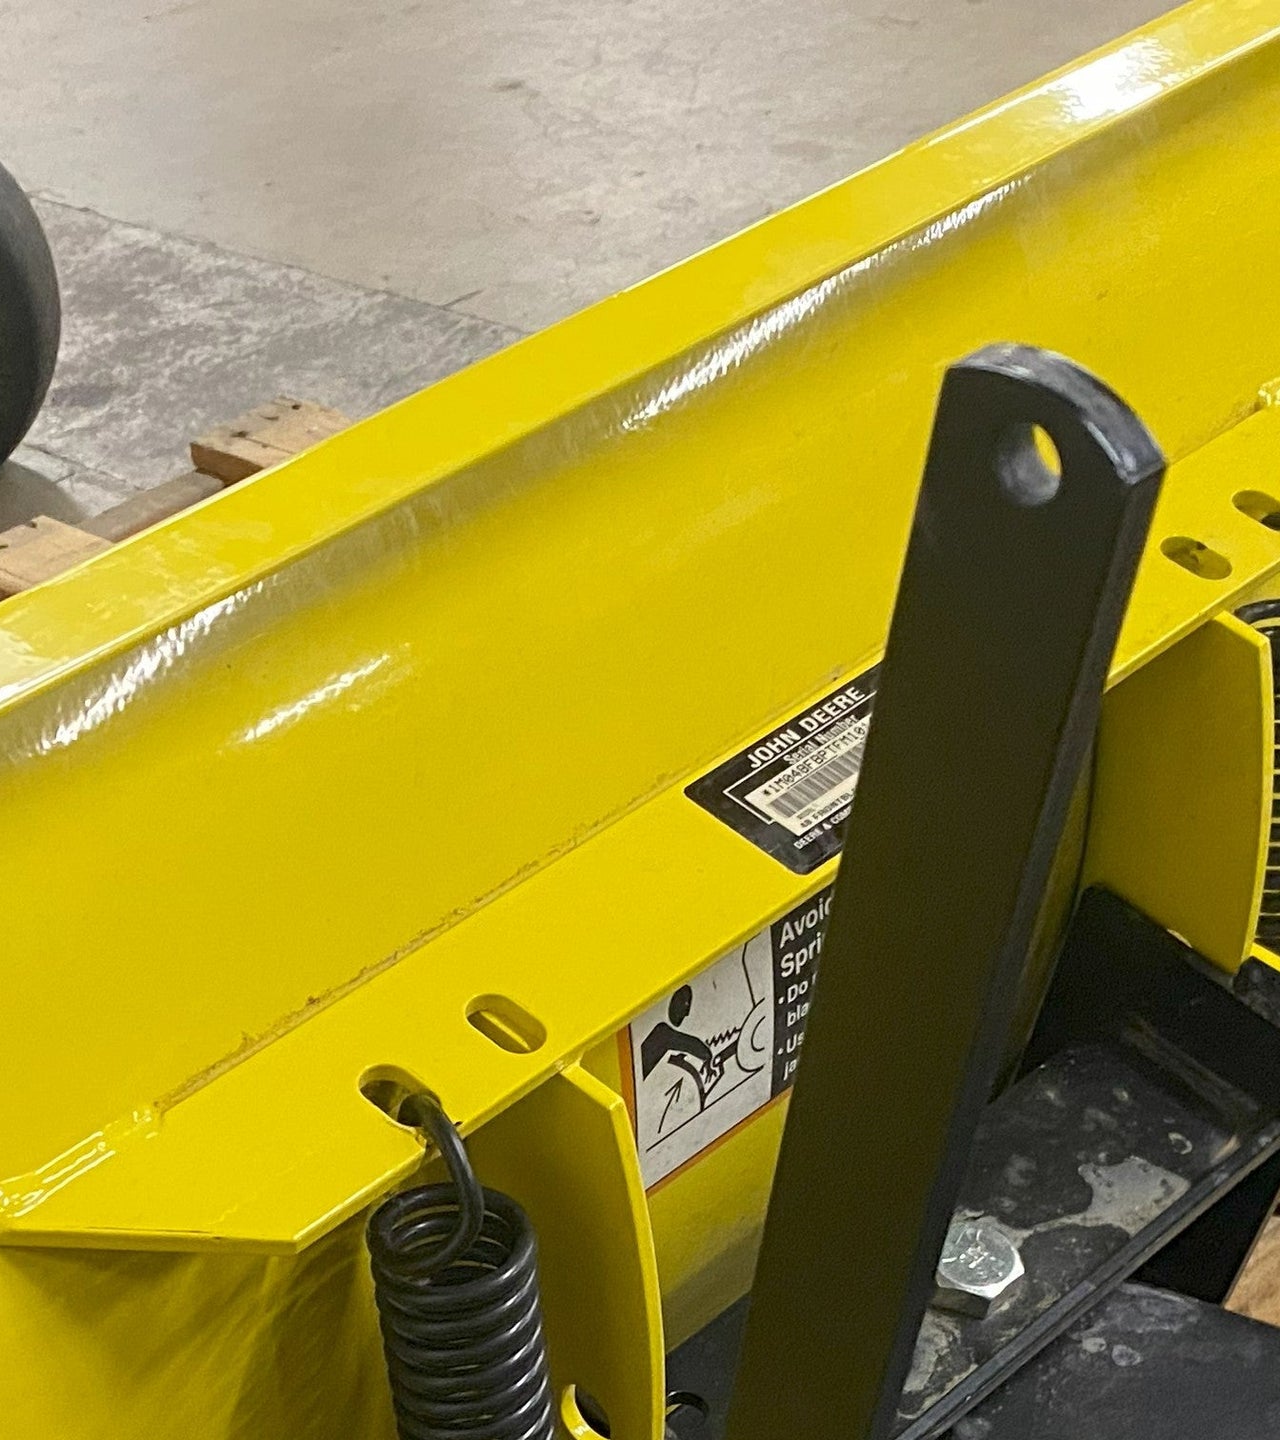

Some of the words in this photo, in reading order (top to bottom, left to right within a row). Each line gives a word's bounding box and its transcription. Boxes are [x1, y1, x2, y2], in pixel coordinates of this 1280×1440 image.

[747, 728, 801, 769] JOHN
[798, 686, 866, 732] DEERE
[783, 740, 818, 765] Serial
[780, 932, 825, 978] Spri
[787, 980, 809, 1004] Do
[787, 1001, 810, 1028] bla
[786, 1031, 805, 1054] Us
[783, 1059, 798, 1081] ja
